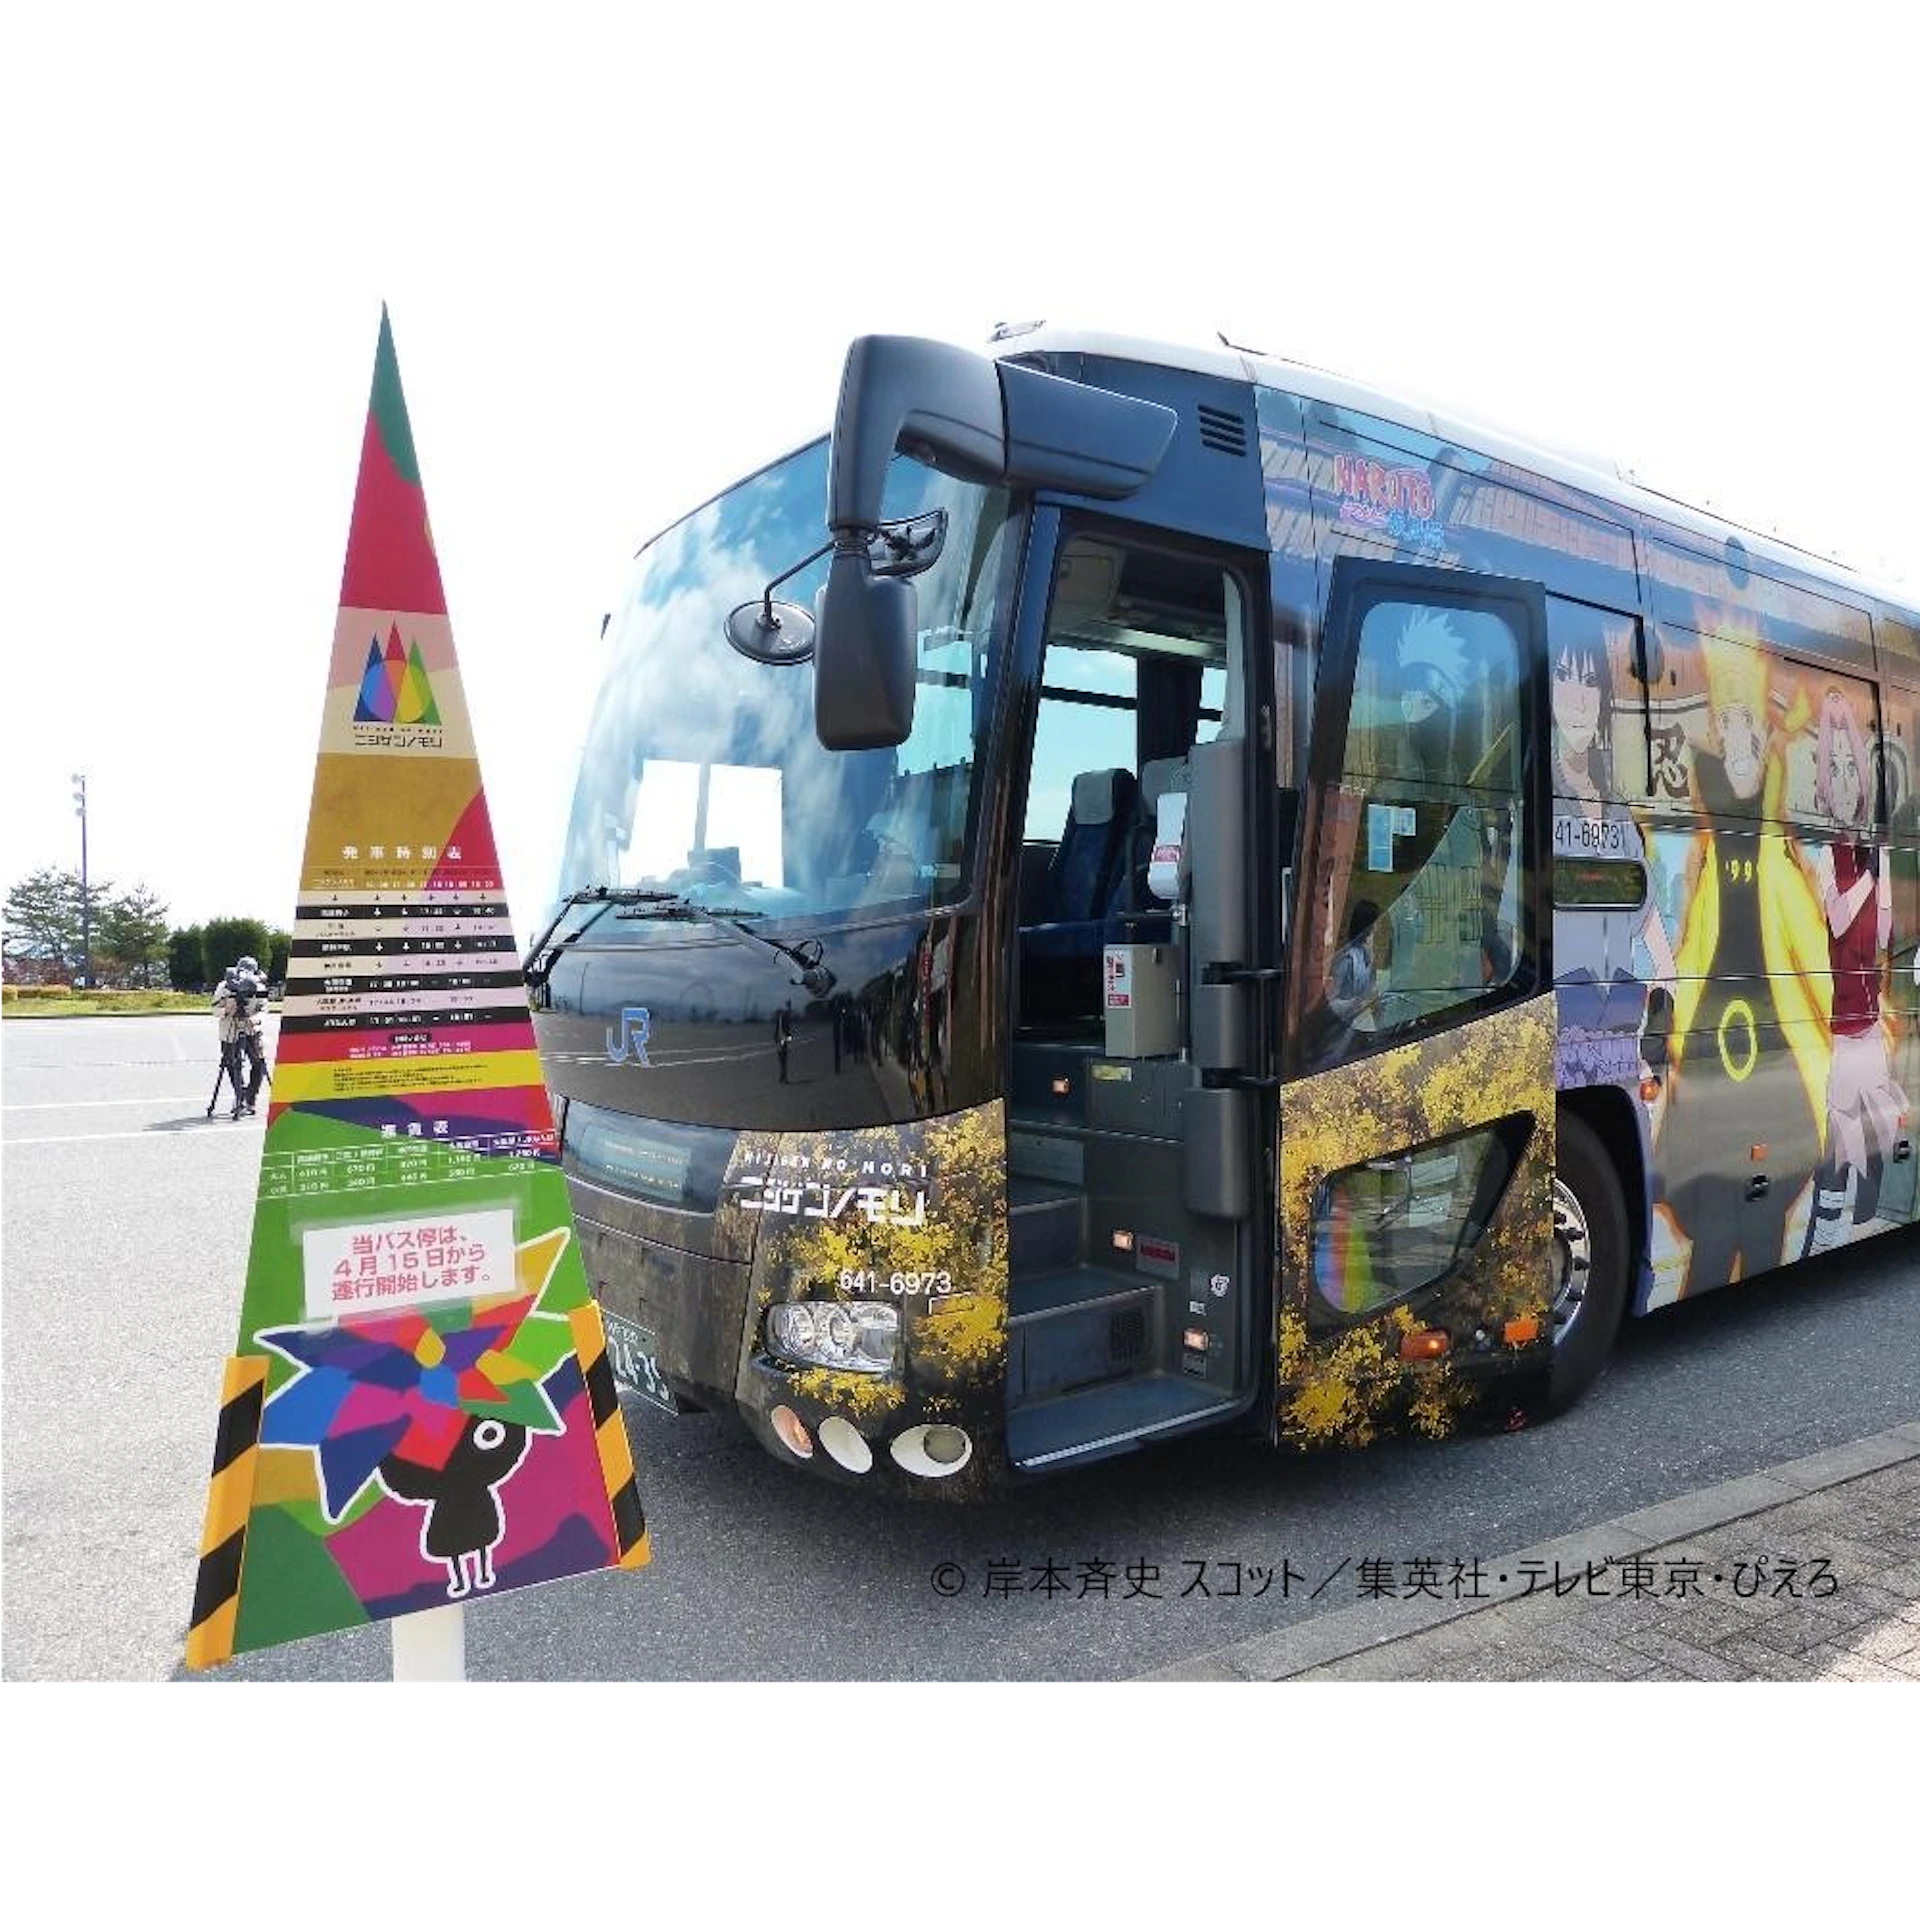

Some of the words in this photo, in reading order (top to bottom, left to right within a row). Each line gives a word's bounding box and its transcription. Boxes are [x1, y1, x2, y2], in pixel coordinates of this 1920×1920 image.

[1333, 454, 1436, 520] NARUTO
[606, 1006, 652, 1068] JR
[821, 1158, 848, 1172] NO
[352, 1225, 468, 1255] 当バス停は、
[332, 1264, 491, 1301] 運行開始します。
[838, 1267, 953, 1296] 641-6973
